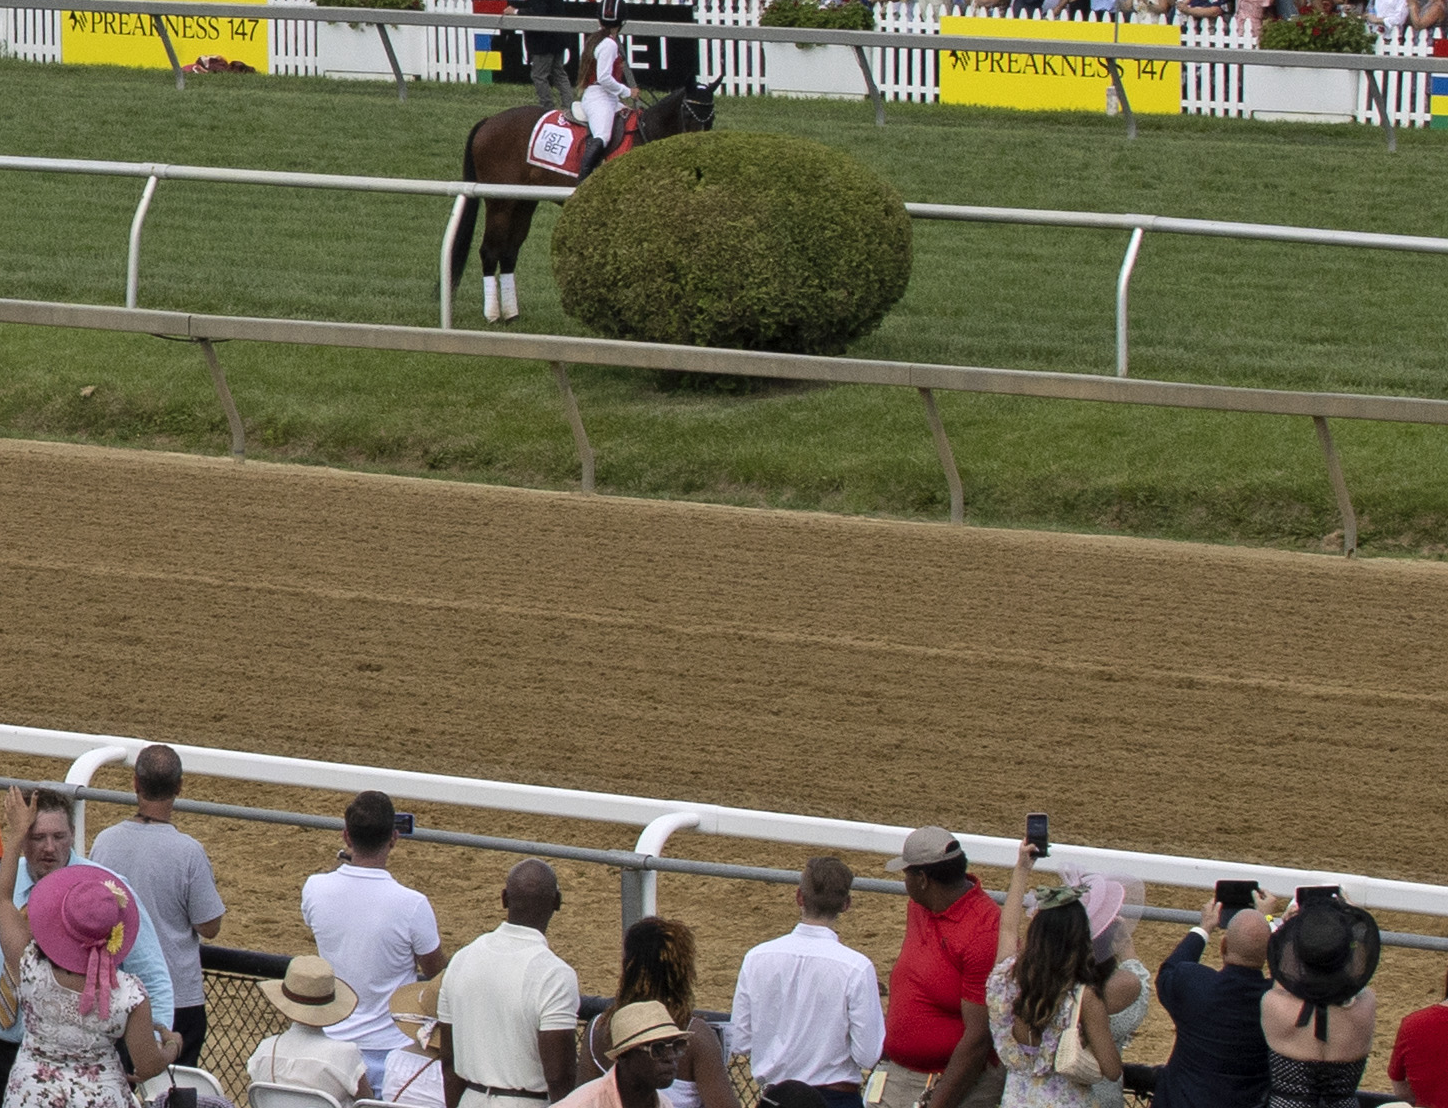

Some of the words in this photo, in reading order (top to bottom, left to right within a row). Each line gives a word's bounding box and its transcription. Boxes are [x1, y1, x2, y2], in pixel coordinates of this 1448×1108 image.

[227, 19, 259, 41] 147
[1134, 59, 1169, 80] 147
[544, 141, 567, 156] BET
